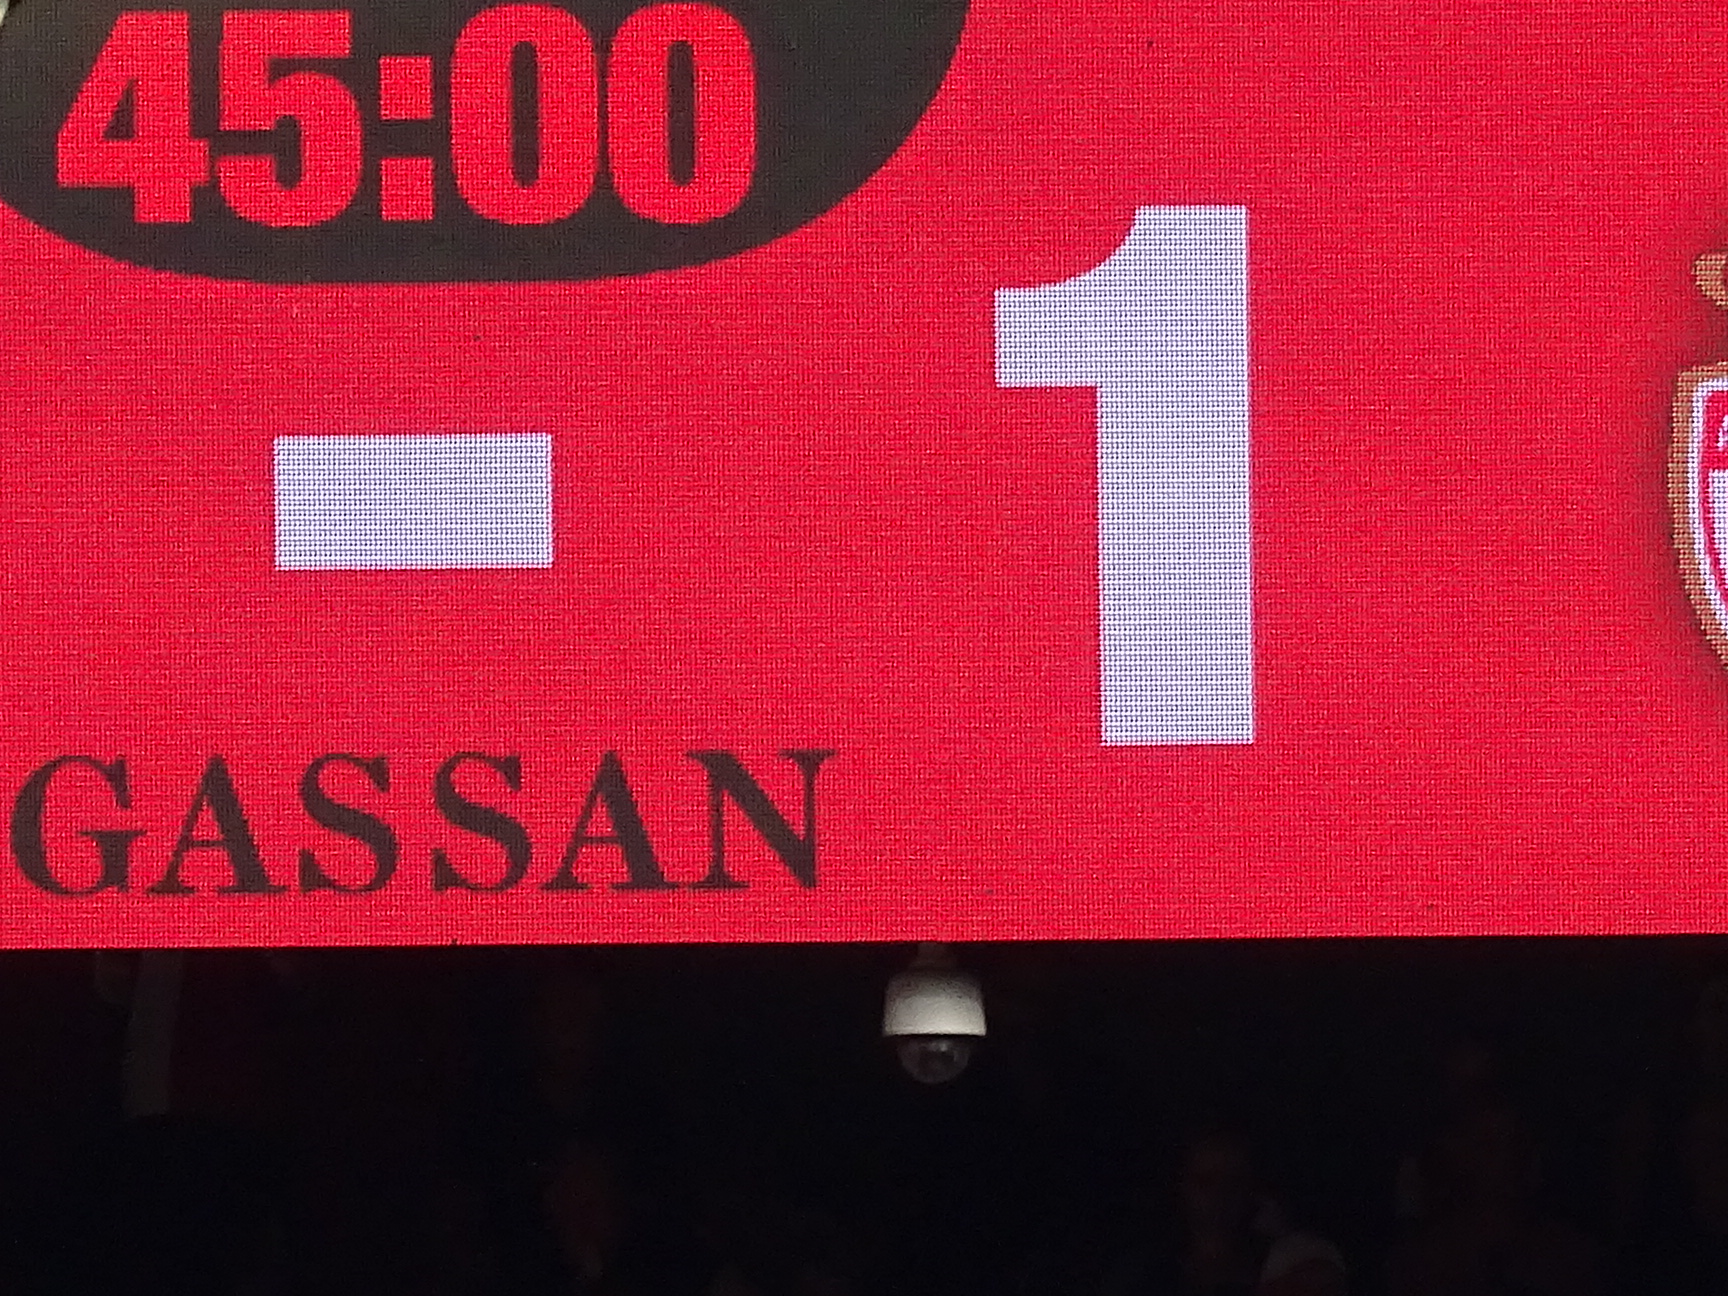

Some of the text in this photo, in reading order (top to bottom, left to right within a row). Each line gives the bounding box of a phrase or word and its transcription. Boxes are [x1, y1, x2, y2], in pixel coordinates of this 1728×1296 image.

[56, 1, 758, 227] 45:00
[994, 205, 1255, 747] 1
[9, 749, 836, 898] GASSAN
